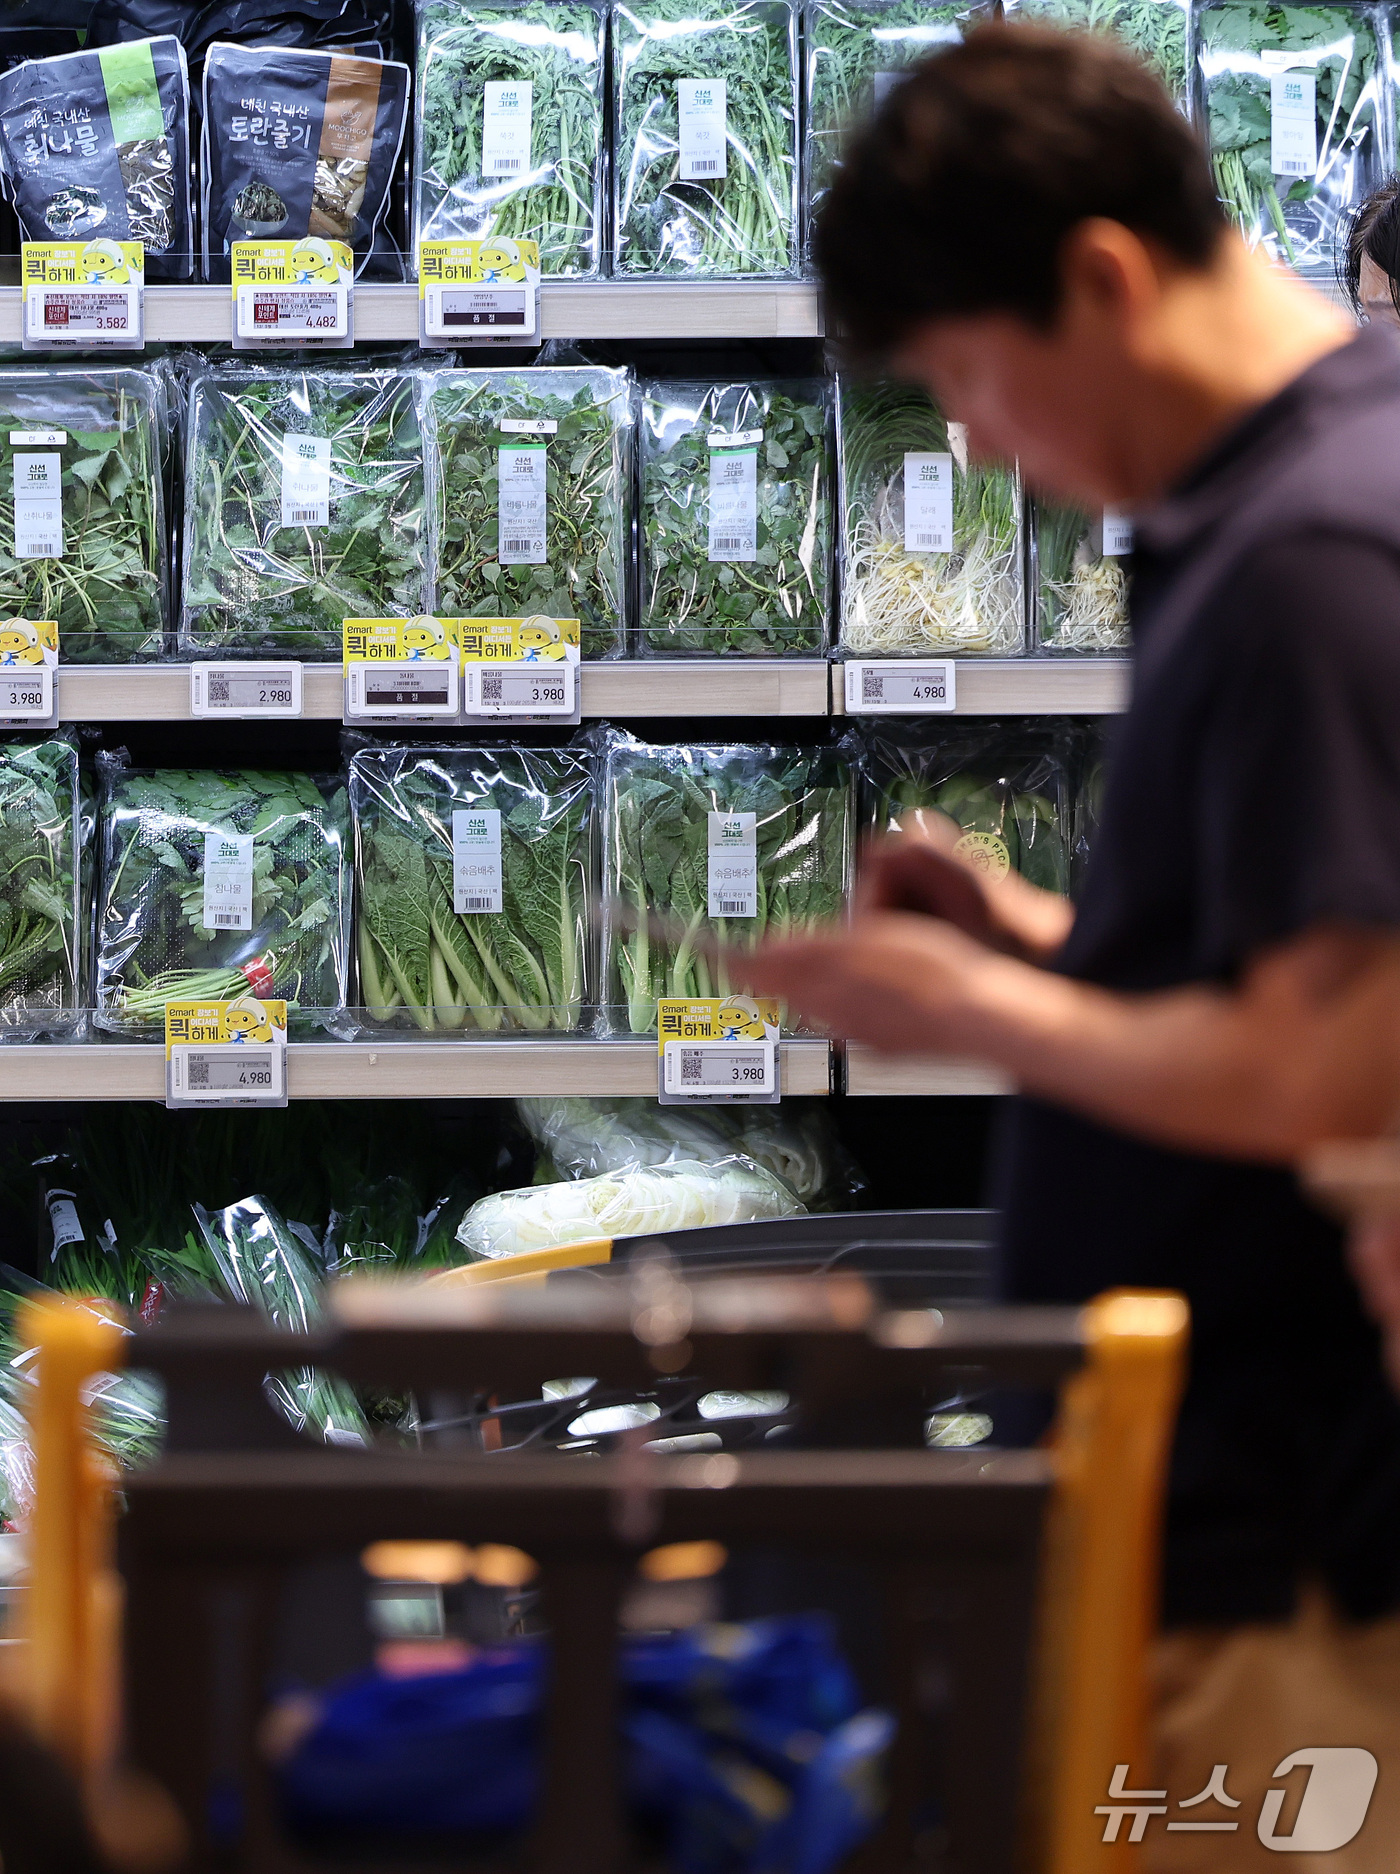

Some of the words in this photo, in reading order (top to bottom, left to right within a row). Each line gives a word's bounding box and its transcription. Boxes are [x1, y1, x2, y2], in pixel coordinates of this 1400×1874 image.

[501, 92, 517, 100] 신선
[695, 90, 711, 98] 신선
[241, 98, 266, 114] 데친
[269, 101, 309, 120] 국내산
[24, 107, 49, 128] 데친
[52, 107, 92, 127] 국내산
[229, 116, 312, 149] 토란줄기
[328, 123, 367, 136] MOOCHIGO
[24, 125, 99, 162] 취나물
[422, 247, 448, 255] emart
[96, 317, 127, 329] 3,582
[306, 316, 336, 328] 4,482
[299, 444, 316, 453] 신선
[514, 457, 532, 466] 신선
[726, 462, 742, 470] 신선
[29, 464, 46, 473] 신선
[512, 466, 534, 474] 그대로
[921, 465, 938, 473] 신선
[723, 470, 744, 478] 그대로
[918, 474, 939, 482] 그대로
[506, 500, 537, 510] 비름나물
[23, 512, 53, 520] 산취나물
[347, 626, 372, 634] emart
[463, 625, 488, 633] emart
[259, 690, 291, 703] 2,980
[532, 689, 564, 701] 3,980
[913, 686, 945, 699] 4,980
[10, 692, 42, 705] 3,980
[469, 819, 486, 827] 신선
[724, 821, 741, 829] 신선
[466, 828, 488, 836] 그대로
[220, 842, 237, 850] 신선
[992, 842, 1006, 869] PICK
[460, 865, 495, 876] 솎음배추
[715, 868, 751, 879] 솎음배추
[169, 1008, 195, 1016] emart
[662, 1005, 688, 1013] emart
[239, 1072, 271, 1084] 4,980
[732, 1068, 764, 1080] 3,980
